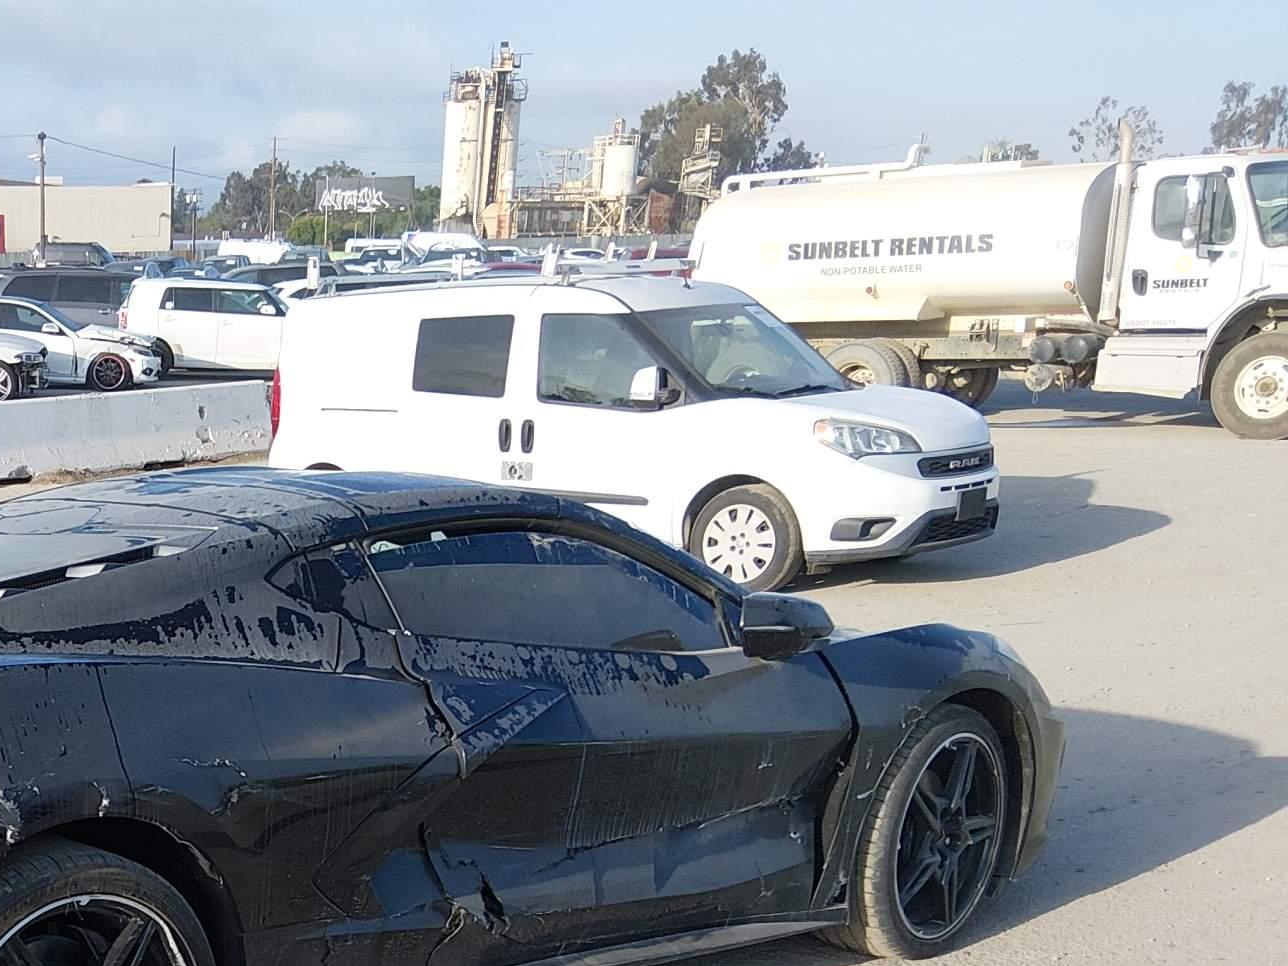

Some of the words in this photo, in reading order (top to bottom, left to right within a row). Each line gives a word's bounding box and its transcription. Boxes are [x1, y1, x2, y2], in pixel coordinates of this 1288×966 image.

[788, 239, 883, 261] SUNBELT
[889, 233, 993, 257] RENTALS
[820, 265, 886, 276] NON-POTABLE
[889, 263, 922, 274] WATER
[1152, 278, 1209, 289] SUNBELT
